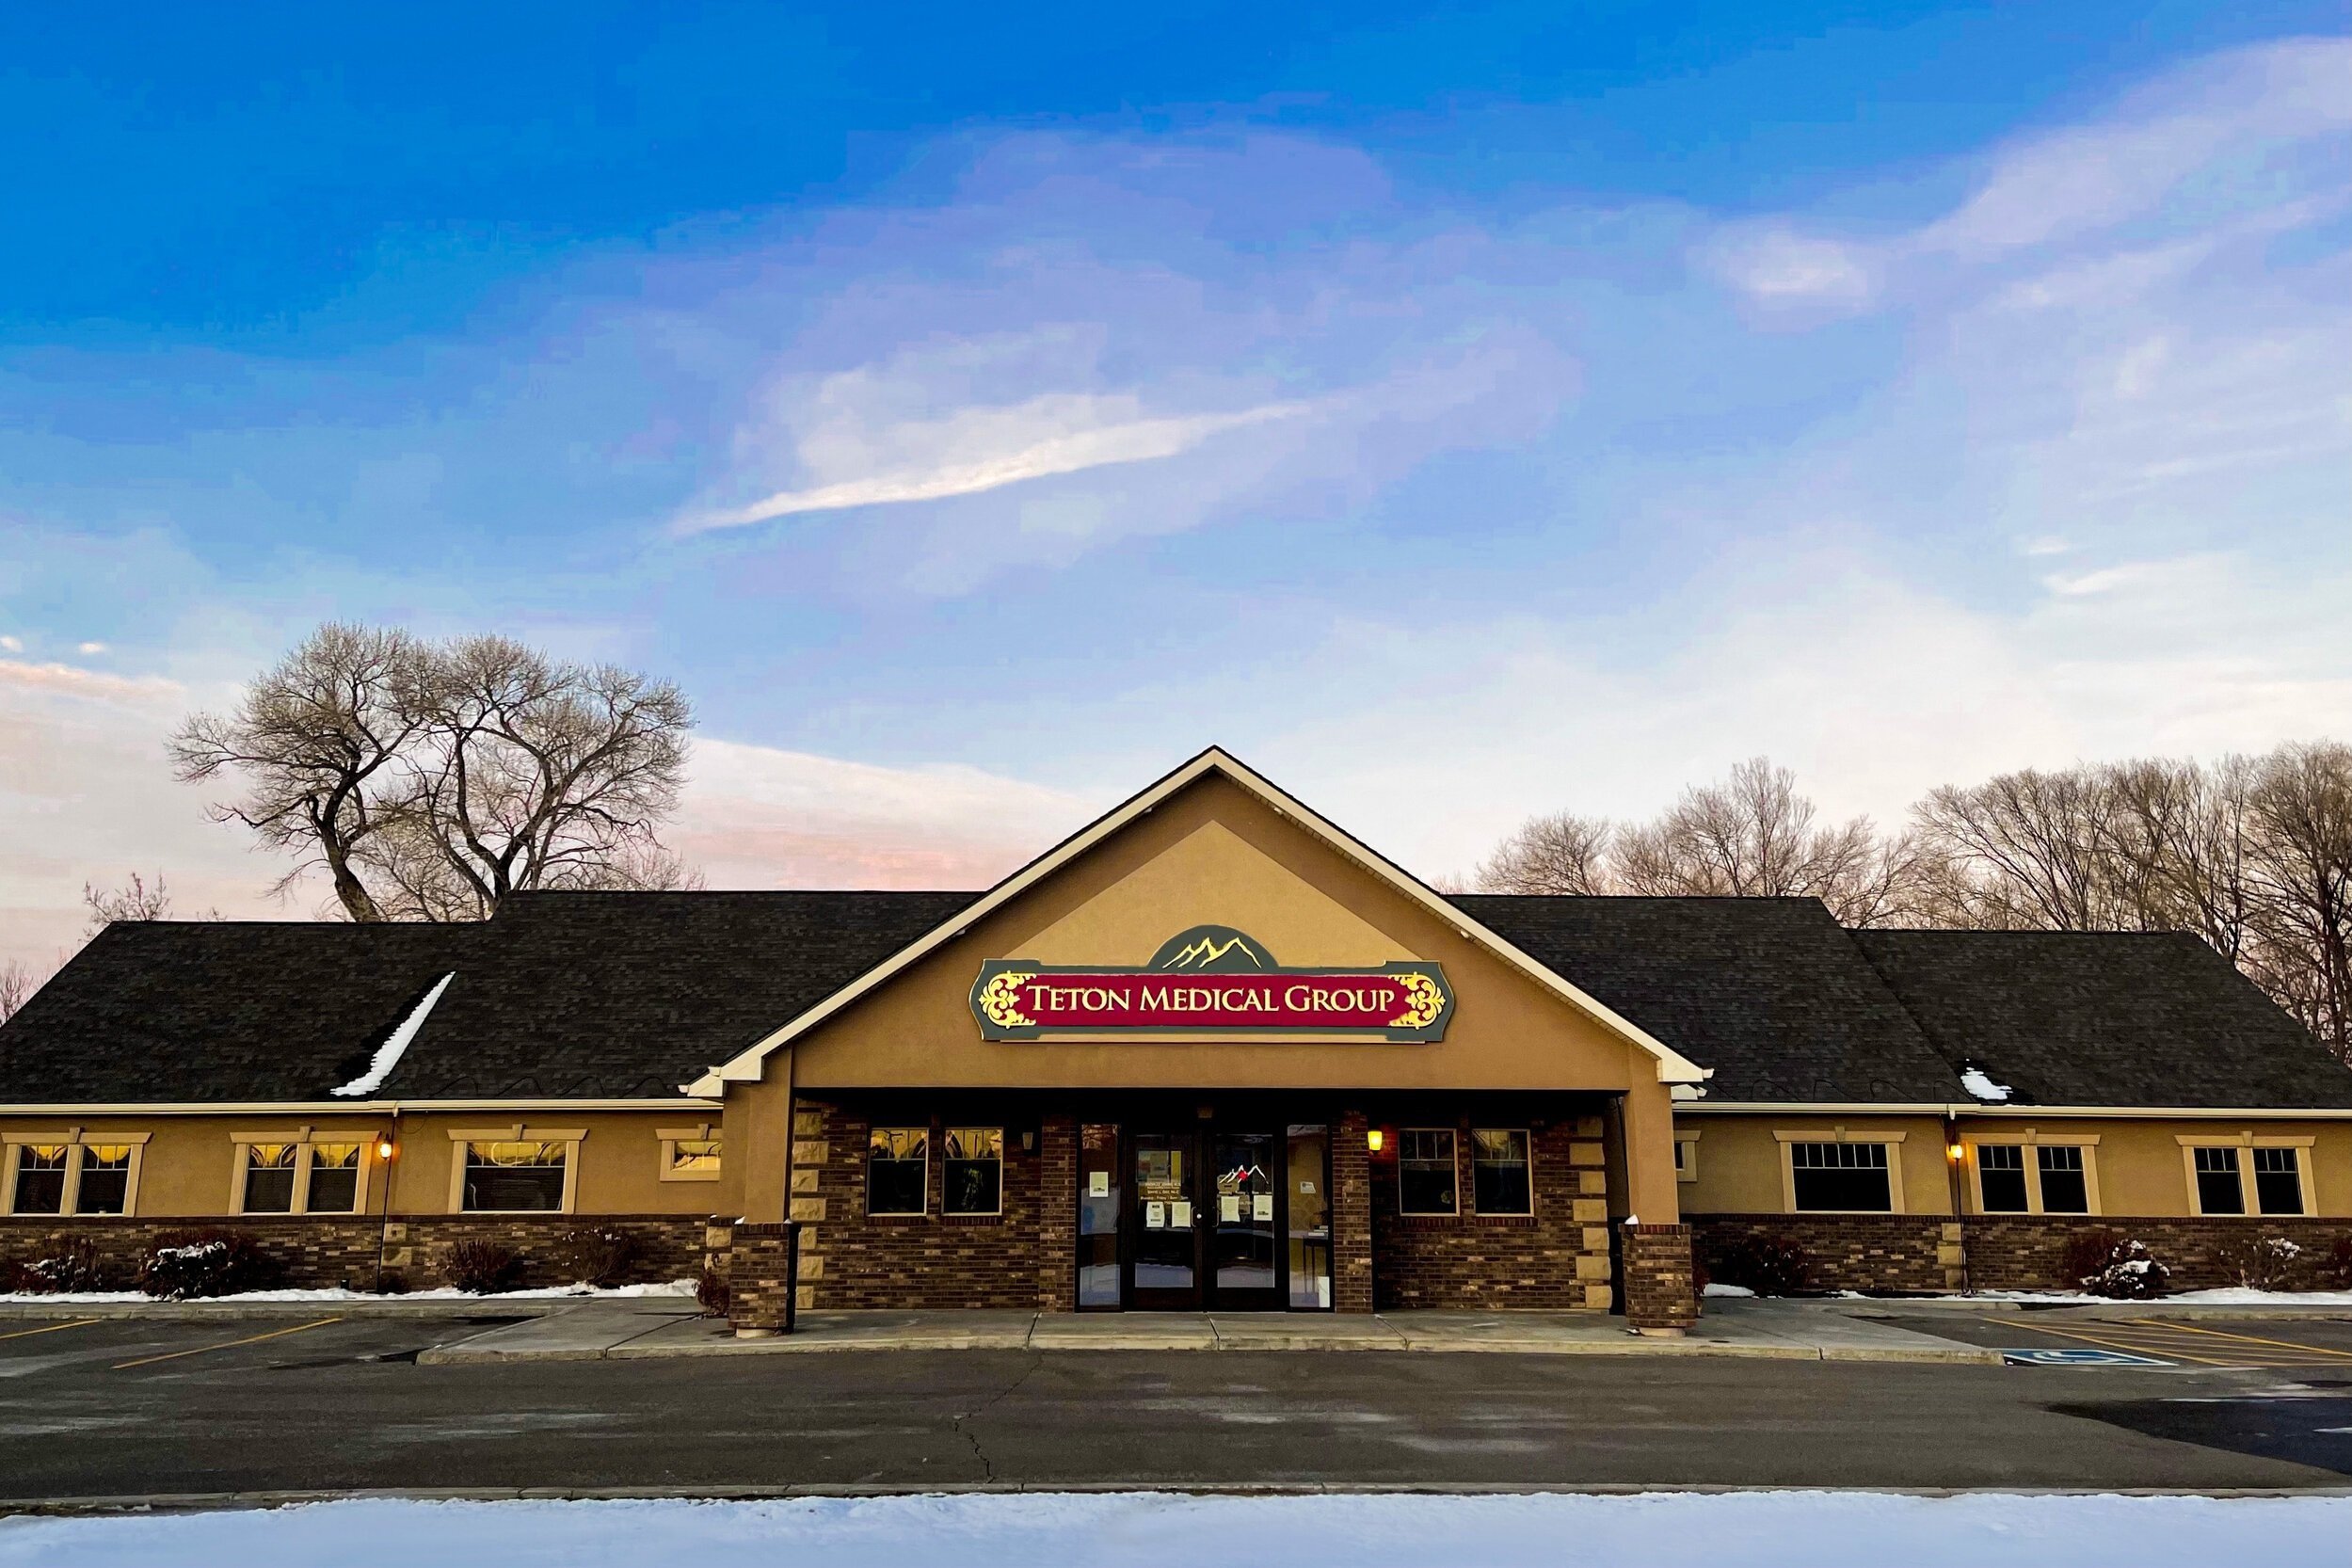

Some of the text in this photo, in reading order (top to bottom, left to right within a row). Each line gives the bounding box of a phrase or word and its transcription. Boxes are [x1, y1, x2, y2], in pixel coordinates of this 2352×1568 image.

[1026, 984, 1395, 1013] TETON MEDICAL GROUP
